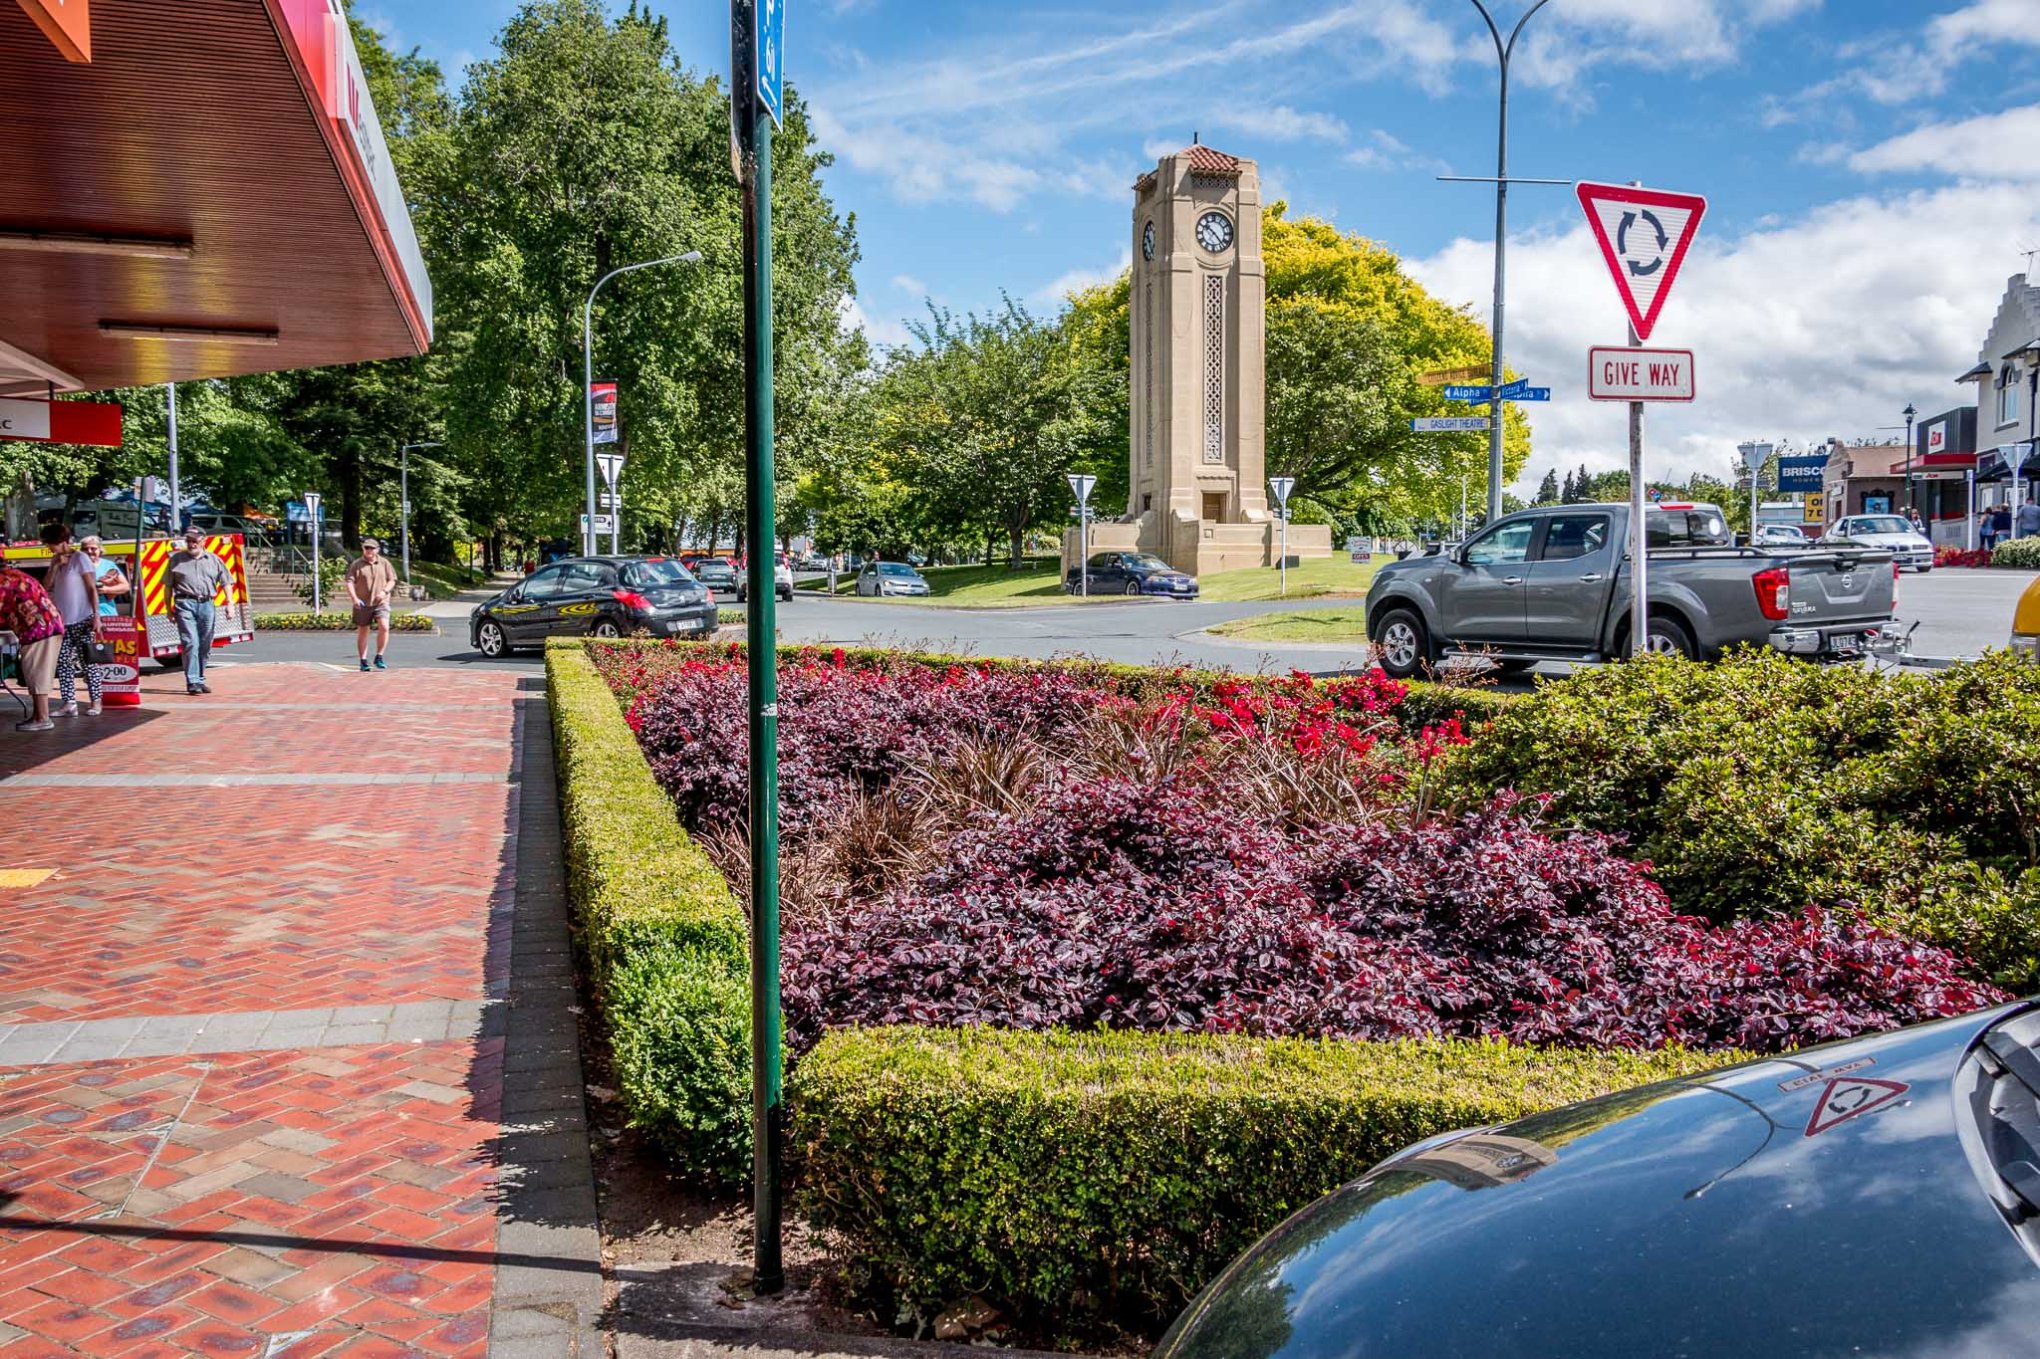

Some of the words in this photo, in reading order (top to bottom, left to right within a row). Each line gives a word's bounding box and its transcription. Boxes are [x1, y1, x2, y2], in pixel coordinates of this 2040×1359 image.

[1604, 361, 1639, 385] GIVE
[1649, 363, 1679, 386] WAY
[1453, 387, 1480, 398] Alpha
[1430, 419, 1457, 429] GASLIGHT
[1460, 418, 1484, 428] THEATRE
